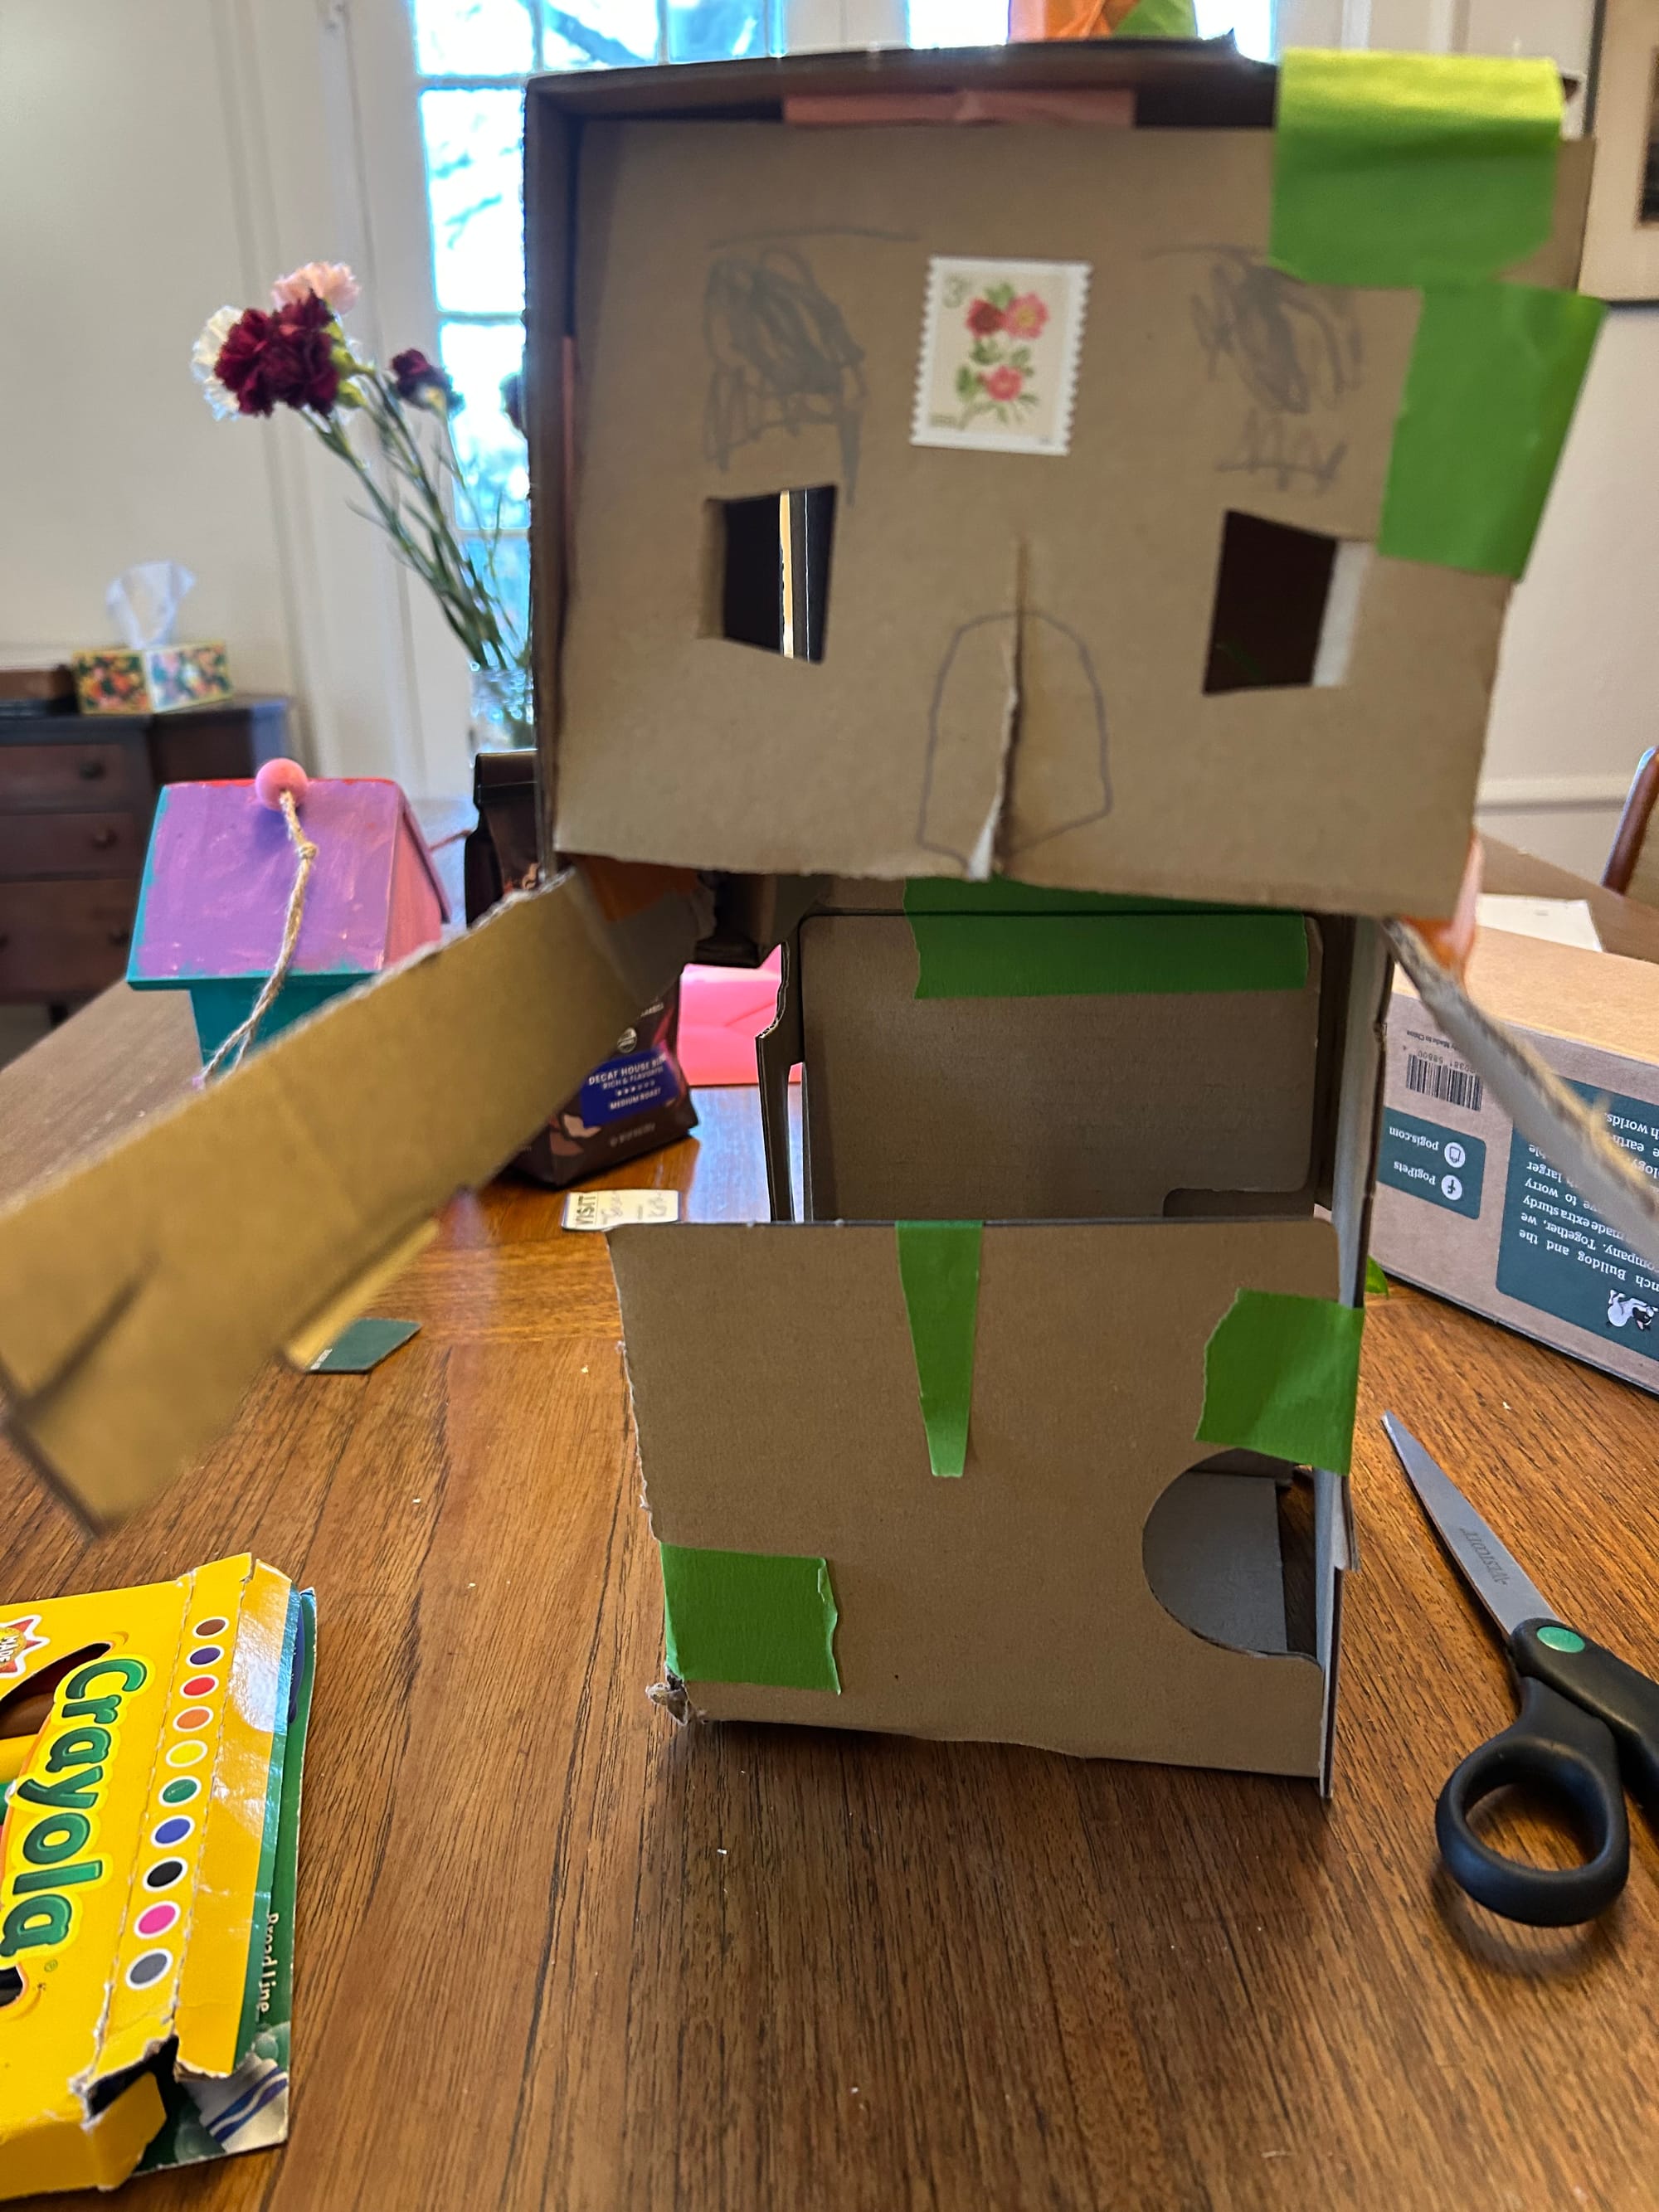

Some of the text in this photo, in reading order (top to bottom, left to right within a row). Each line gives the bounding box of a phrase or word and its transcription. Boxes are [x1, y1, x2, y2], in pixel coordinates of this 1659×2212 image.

[588, 1069, 618, 1086] DECAF
[620, 1061, 649, 1077] HOUSE
[610, 1095, 640, 1110] MEDIUM
[1389, 1126, 1440, 1151] pogis.com
[1393, 1160, 1437, 1186] PogiPets
[1526, 1162, 1562, 1184] larger
[1525, 1177, 1559, 1198] worry
[1522, 1194, 1559, 1216] sturdy
[1564, 1194, 1577, 1206] to
[1520, 1213, 1538, 1226] we
[1560, 1210, 1591, 1228] extra
[1519, 1229, 1539, 1245] the
[1543, 1219, 1597, 1251] Together,
[1546, 1239, 1570, 1256] and
[1577, 1251, 1626, 1281] Bulldog
[0, 1659, 148, 1957] Crayola
